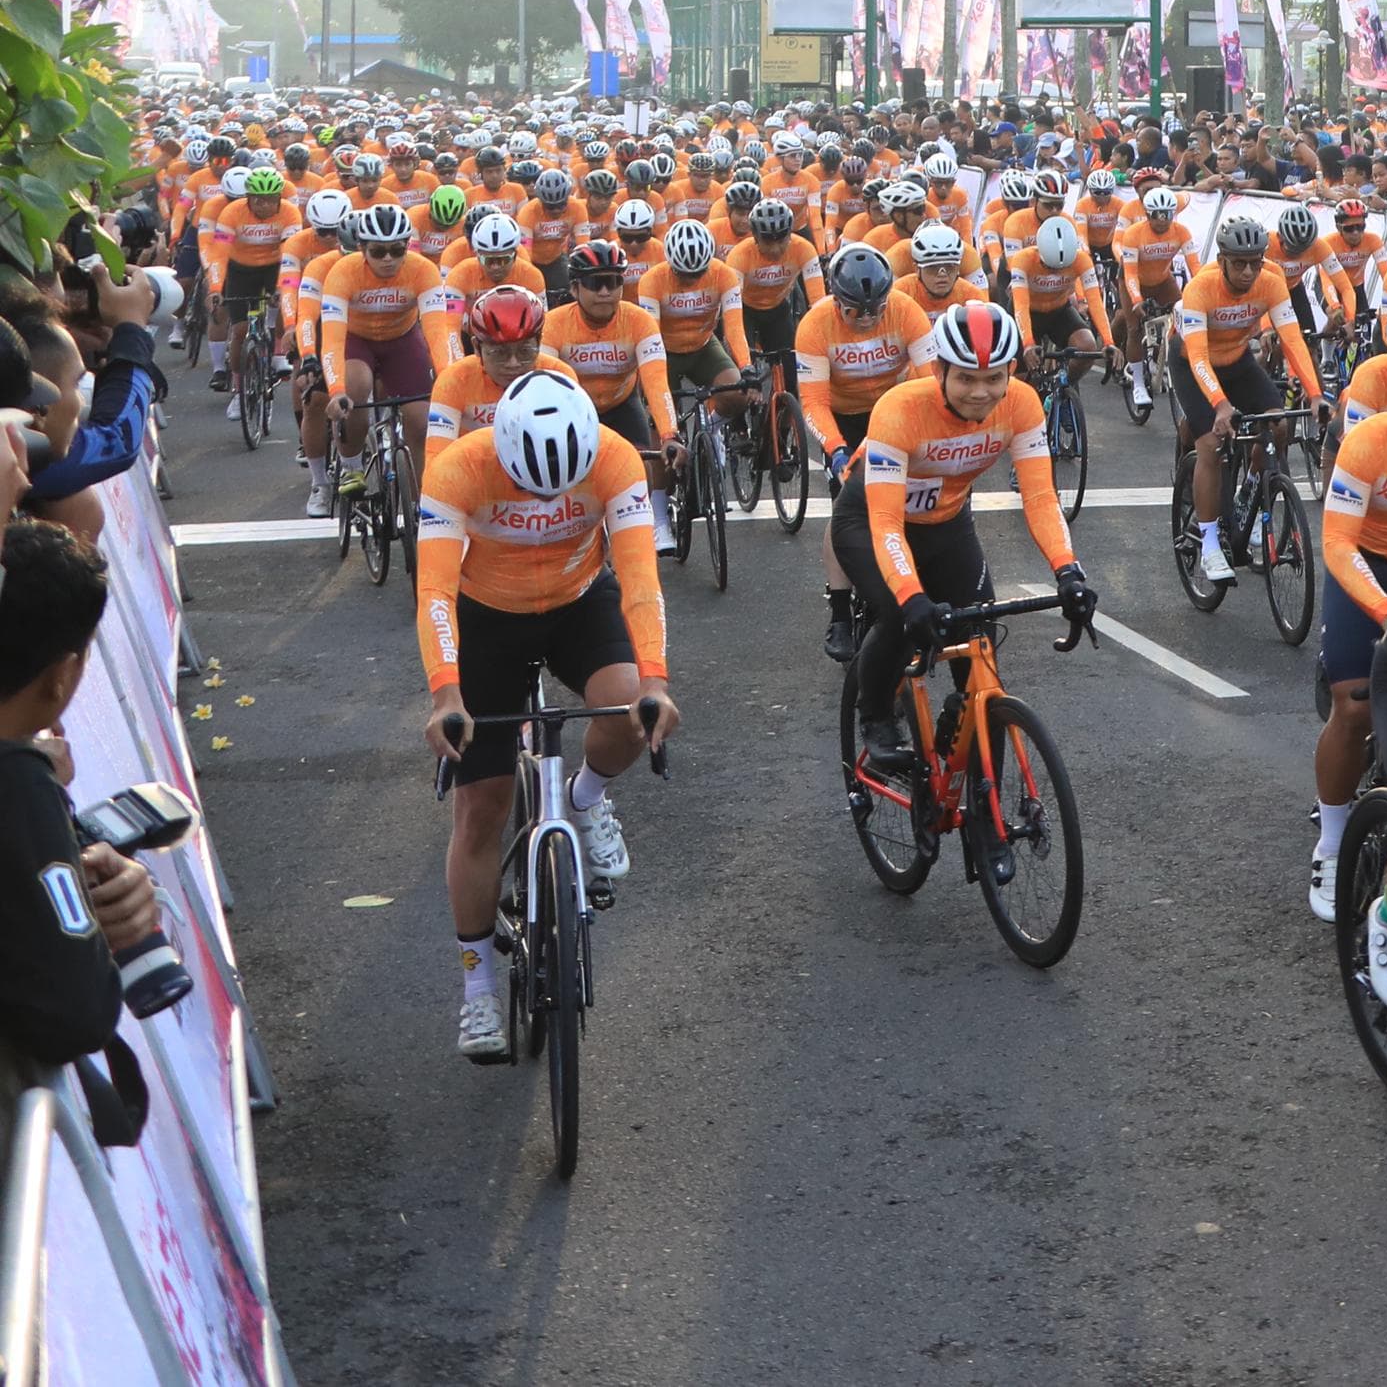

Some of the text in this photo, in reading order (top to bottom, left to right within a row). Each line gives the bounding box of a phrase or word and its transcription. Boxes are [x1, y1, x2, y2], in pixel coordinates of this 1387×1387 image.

[359, 287, 407, 305] Kemala
[669, 293, 712, 310] Kemala
[568, 345, 628, 364] Kemala
[834, 338, 899, 364] Kemala
[474, 405, 495, 425] Ke
[926, 434, 1000, 462] Kemala
[490, 496, 586, 532] Kemala
[884, 530, 912, 576] Kemaa
[430, 598, 458, 664] Kemala
